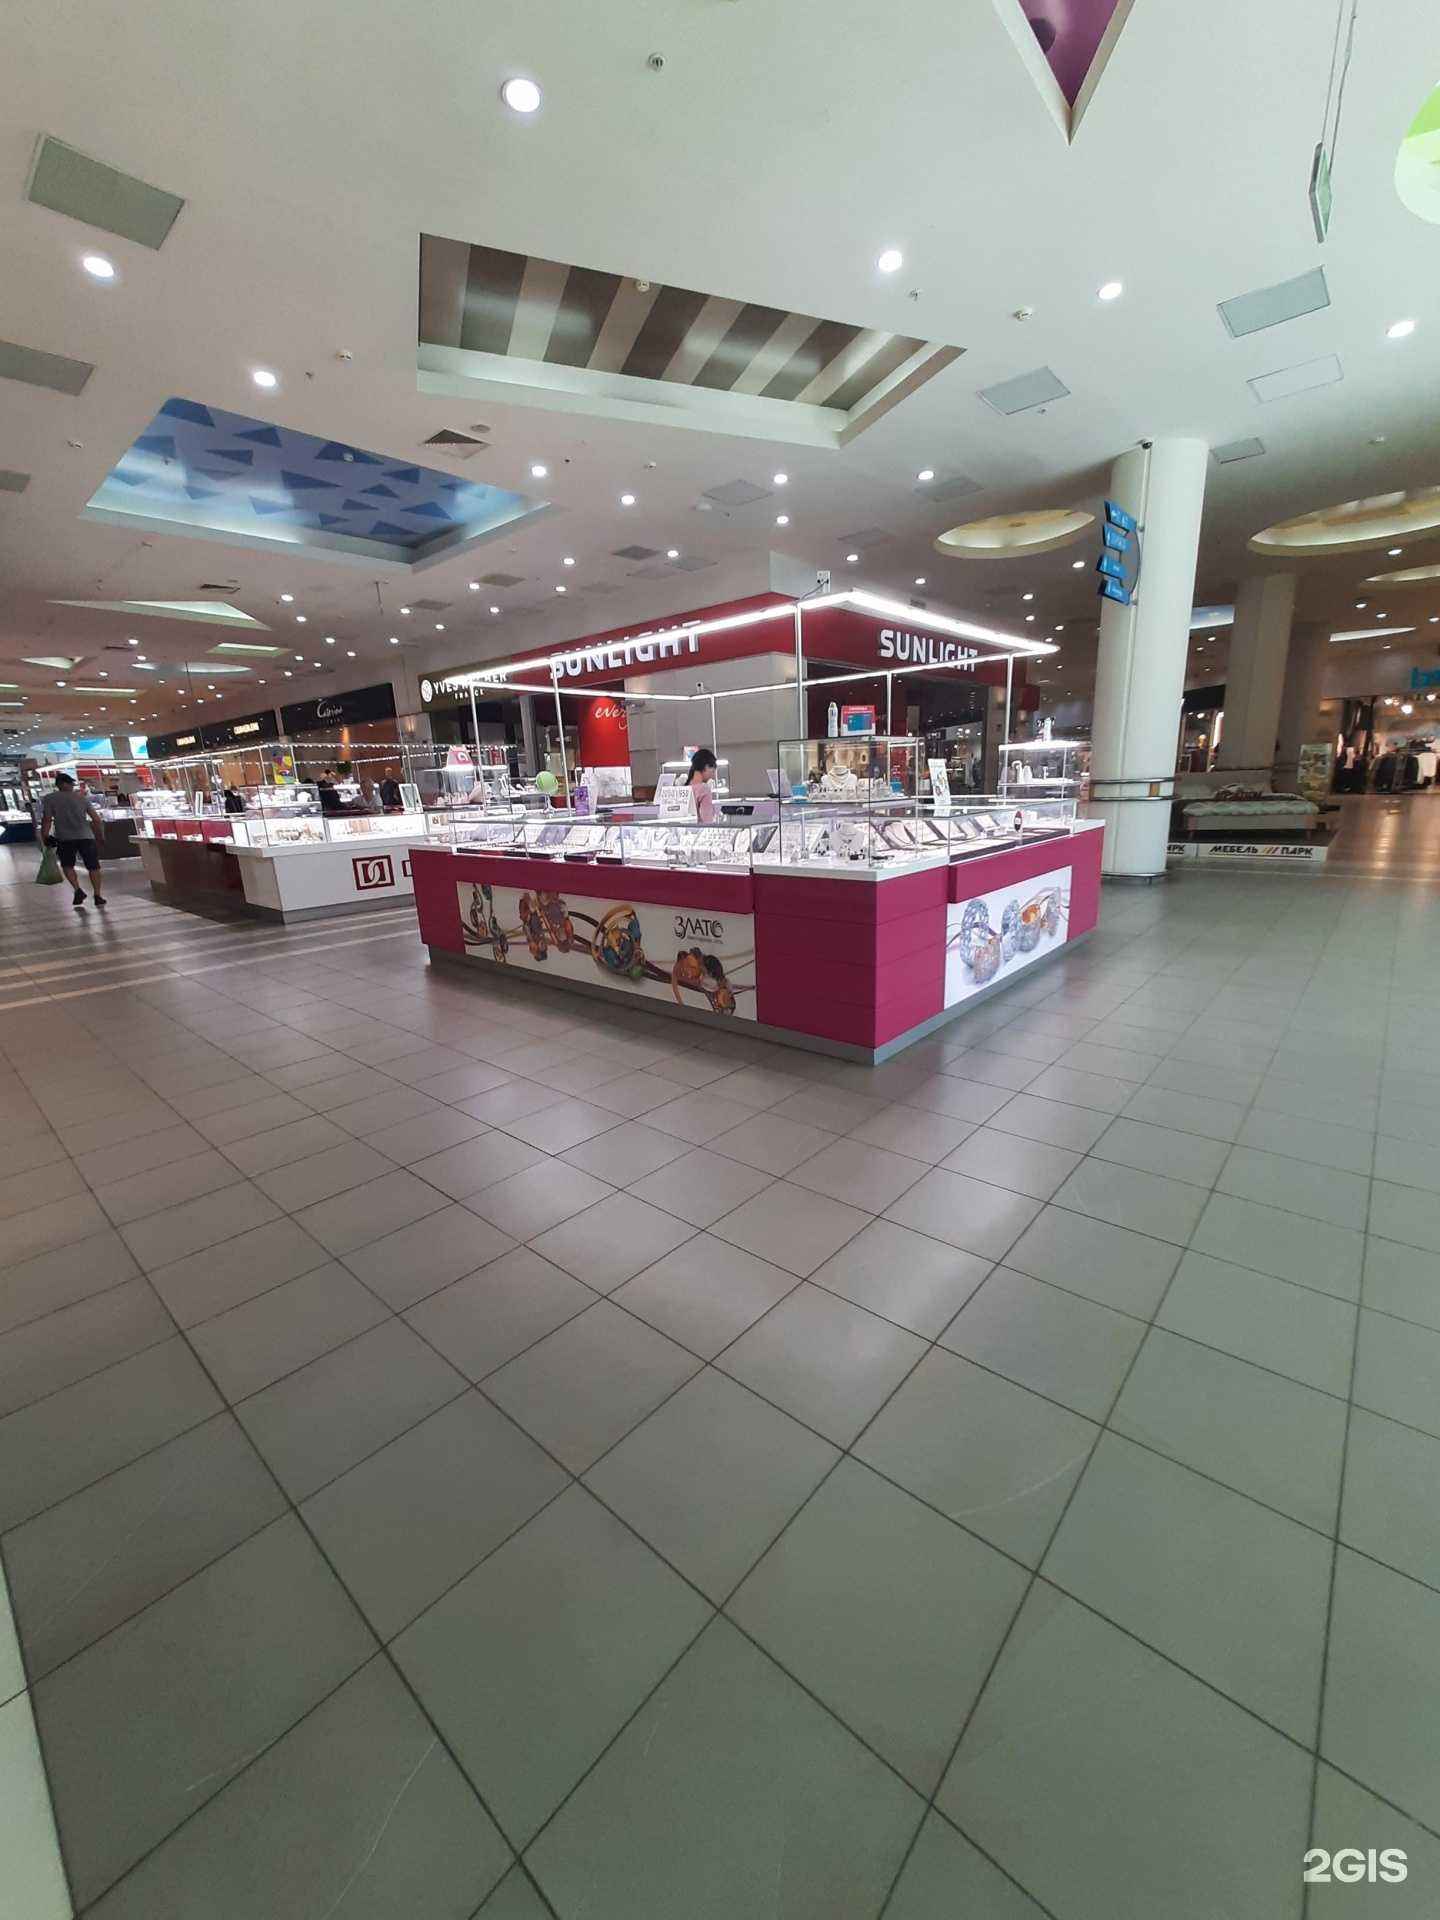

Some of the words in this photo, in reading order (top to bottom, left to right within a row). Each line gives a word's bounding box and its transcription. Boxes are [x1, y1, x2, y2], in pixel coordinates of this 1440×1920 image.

[550, 620, 701, 680] SUNLIGHT
[879, 629, 978, 673] SUNLIGHT
[1209, 844, 1259, 855] МЕБЕЛЬ
[1280, 846, 1314, 857] ПАРК
